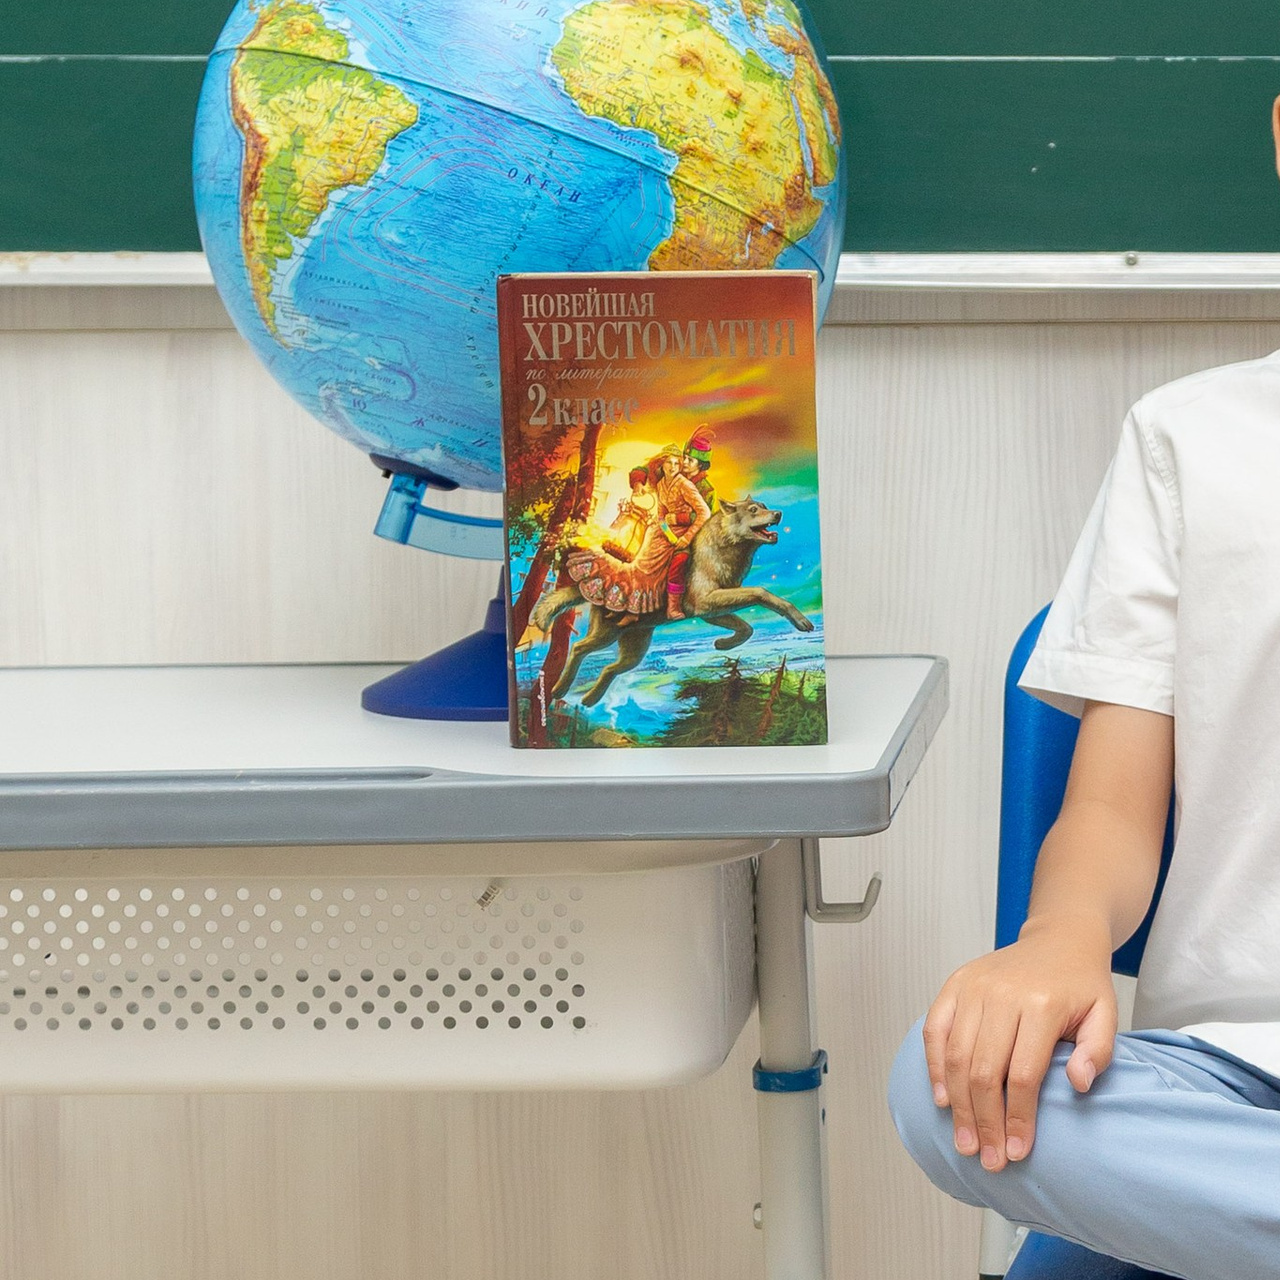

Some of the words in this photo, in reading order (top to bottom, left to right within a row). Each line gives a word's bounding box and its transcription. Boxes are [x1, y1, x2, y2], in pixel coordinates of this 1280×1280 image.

[506, 166, 582, 204] ОКЕАН
[521, 288, 656, 318] НОВЕЙШАЯ
[523, 319, 797, 361] ХРЕСТОМАТИЯ
[528, 383, 548, 426] 2
[554, 397, 640, 425] класс
